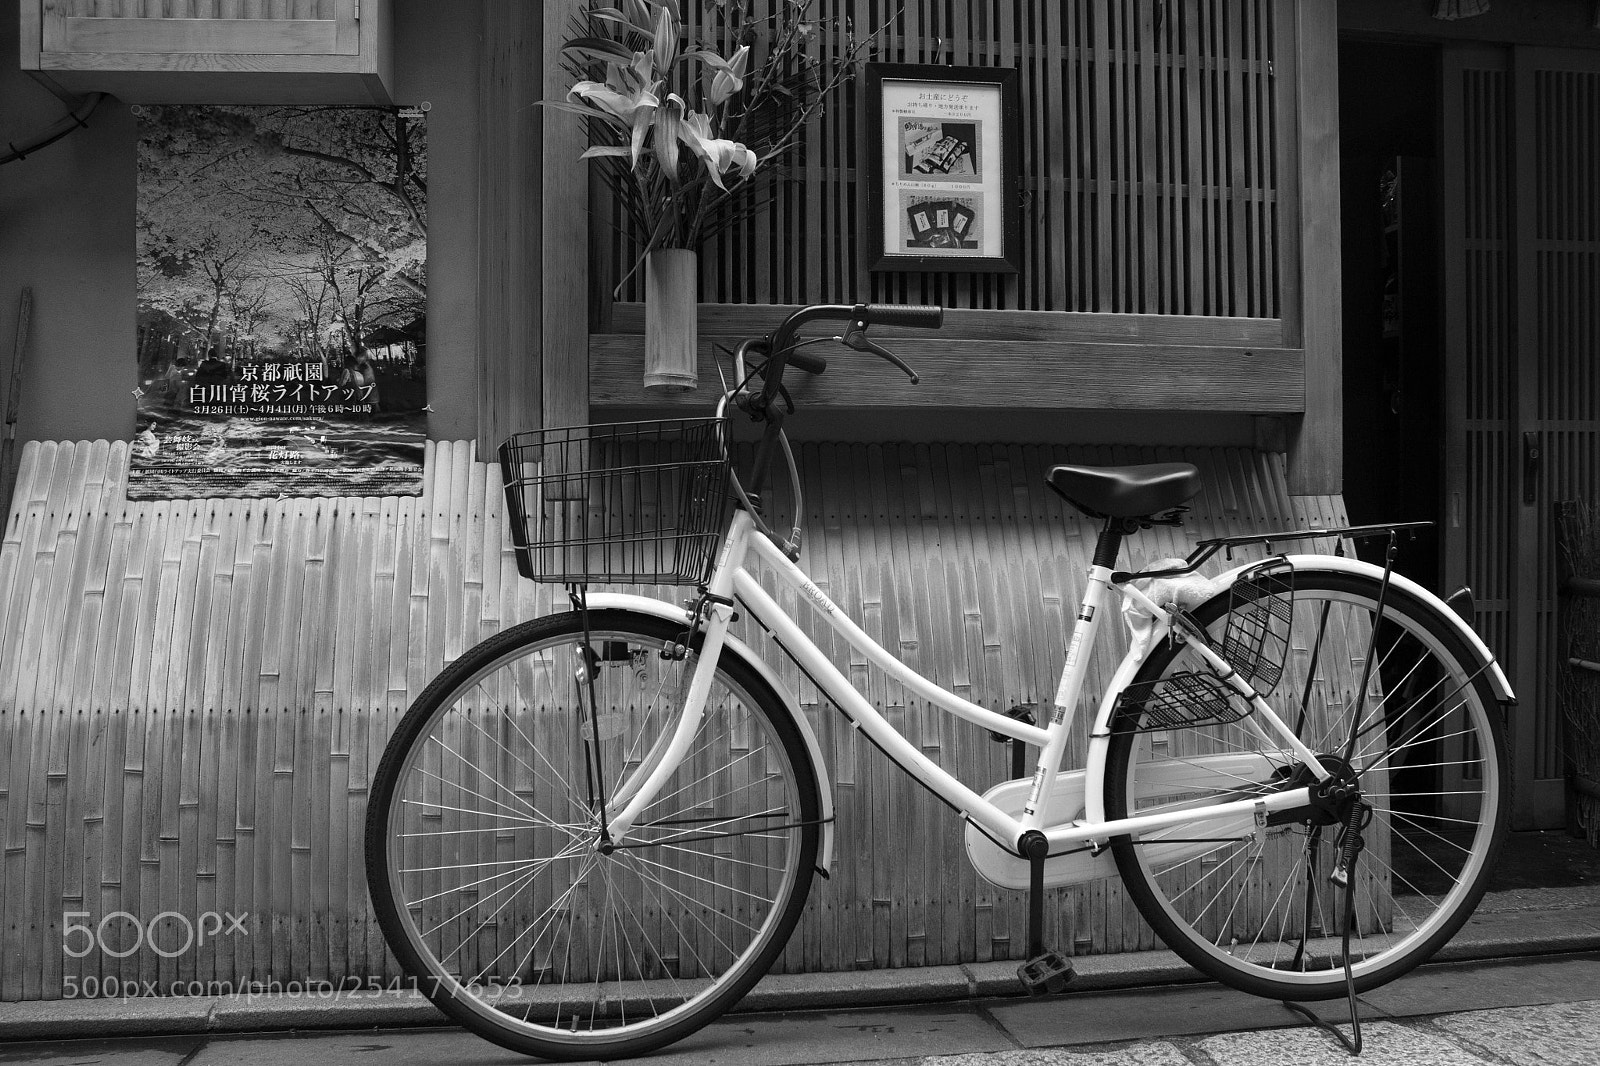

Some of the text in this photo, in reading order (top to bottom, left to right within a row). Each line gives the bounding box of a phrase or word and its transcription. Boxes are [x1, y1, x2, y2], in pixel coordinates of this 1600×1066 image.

[919, 93, 969, 102] お土産にどうぞ
[240, 362, 323, 382] 京都祇園
[189, 382, 377, 403] 白川宵桜ライトアップ
